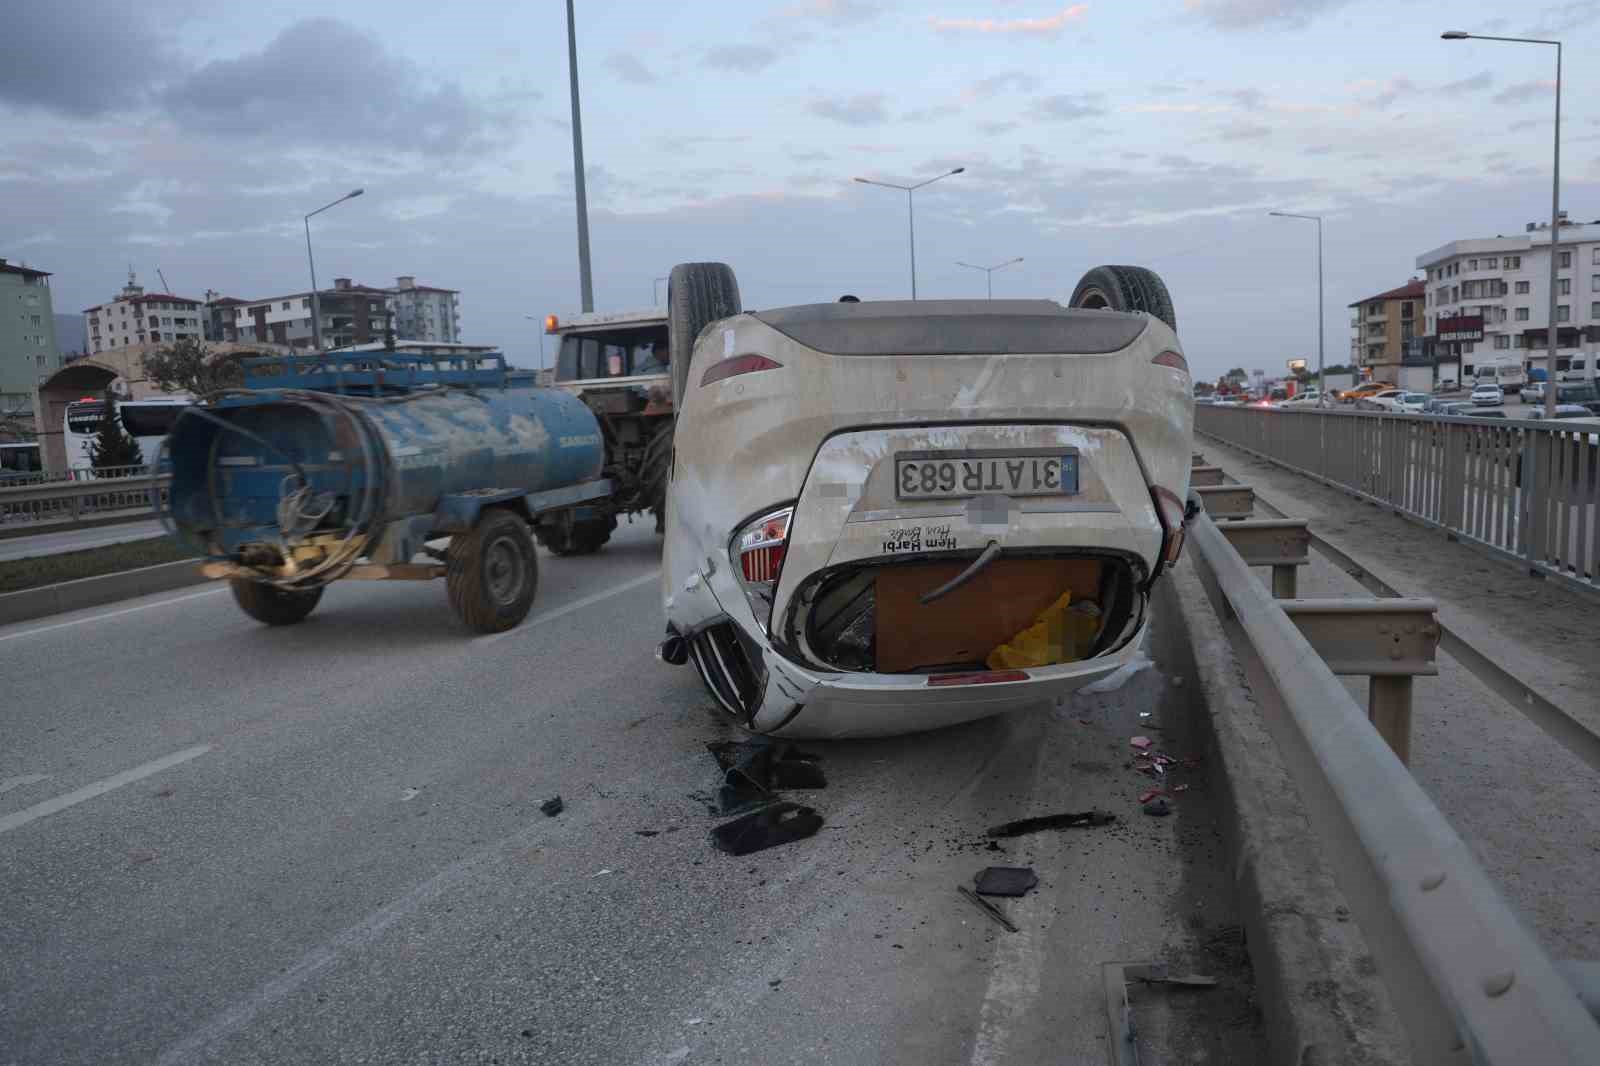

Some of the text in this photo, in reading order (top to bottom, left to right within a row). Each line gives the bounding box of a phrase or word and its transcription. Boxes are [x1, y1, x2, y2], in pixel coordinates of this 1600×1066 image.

[902, 463, 956, 493] 683
[963, 460, 1025, 490] ATR
[1032, 460, 1060, 489] 31
[882, 538, 957, 553] Hem Harbi
